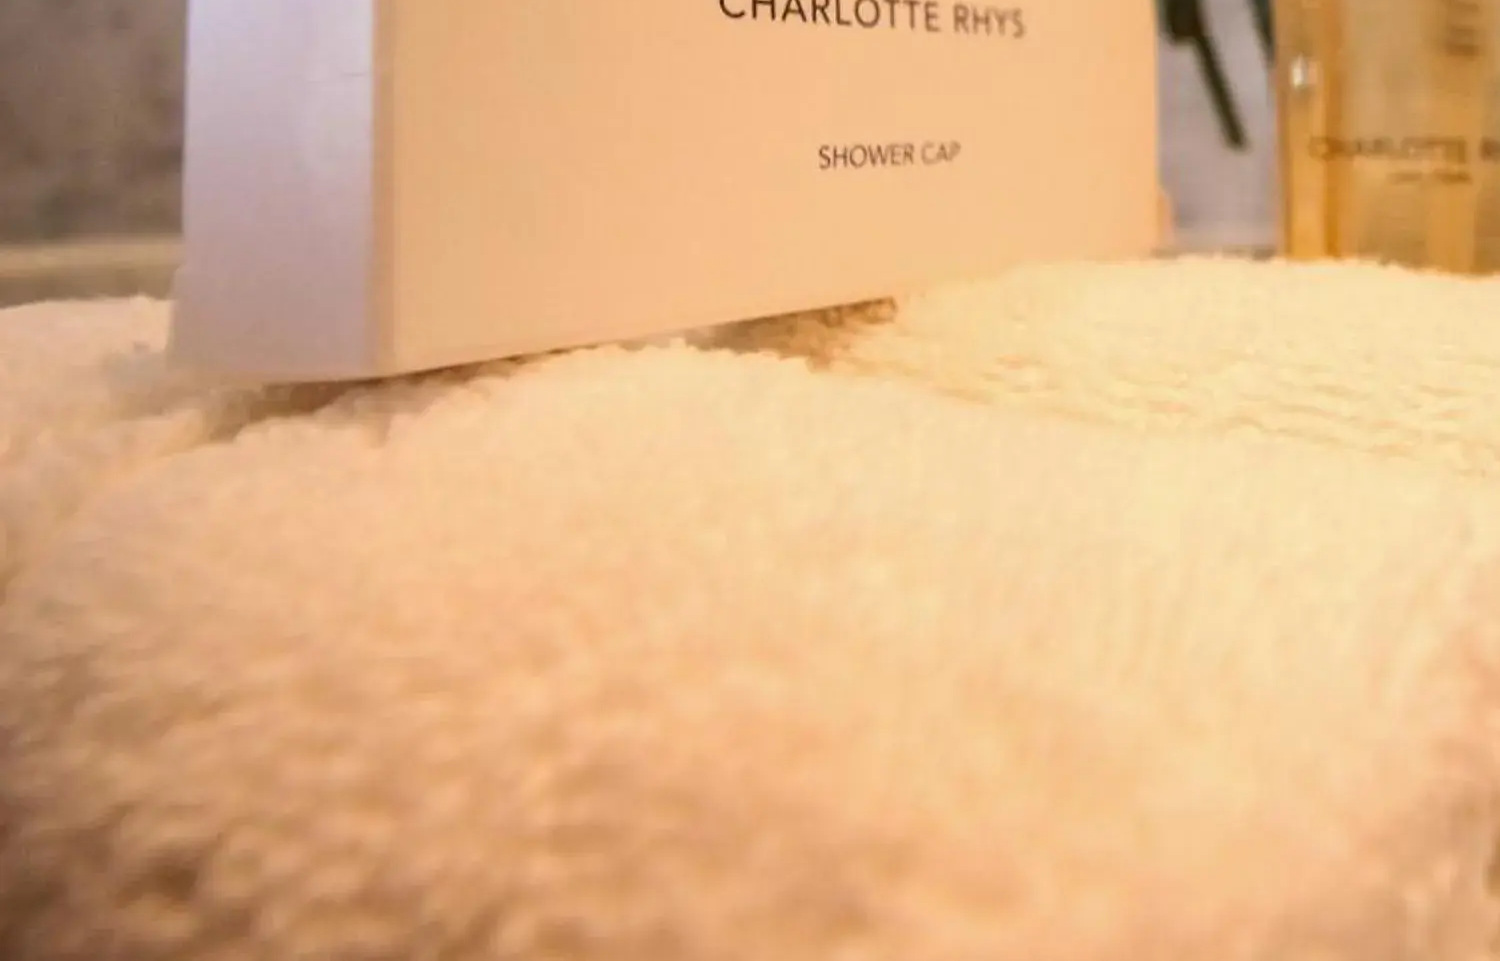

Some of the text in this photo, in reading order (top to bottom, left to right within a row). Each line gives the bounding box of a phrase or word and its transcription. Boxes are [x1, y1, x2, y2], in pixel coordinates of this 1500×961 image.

[953, 1, 1027, 39] RHYS
[818, 141, 961, 170] SHOWER CAP
